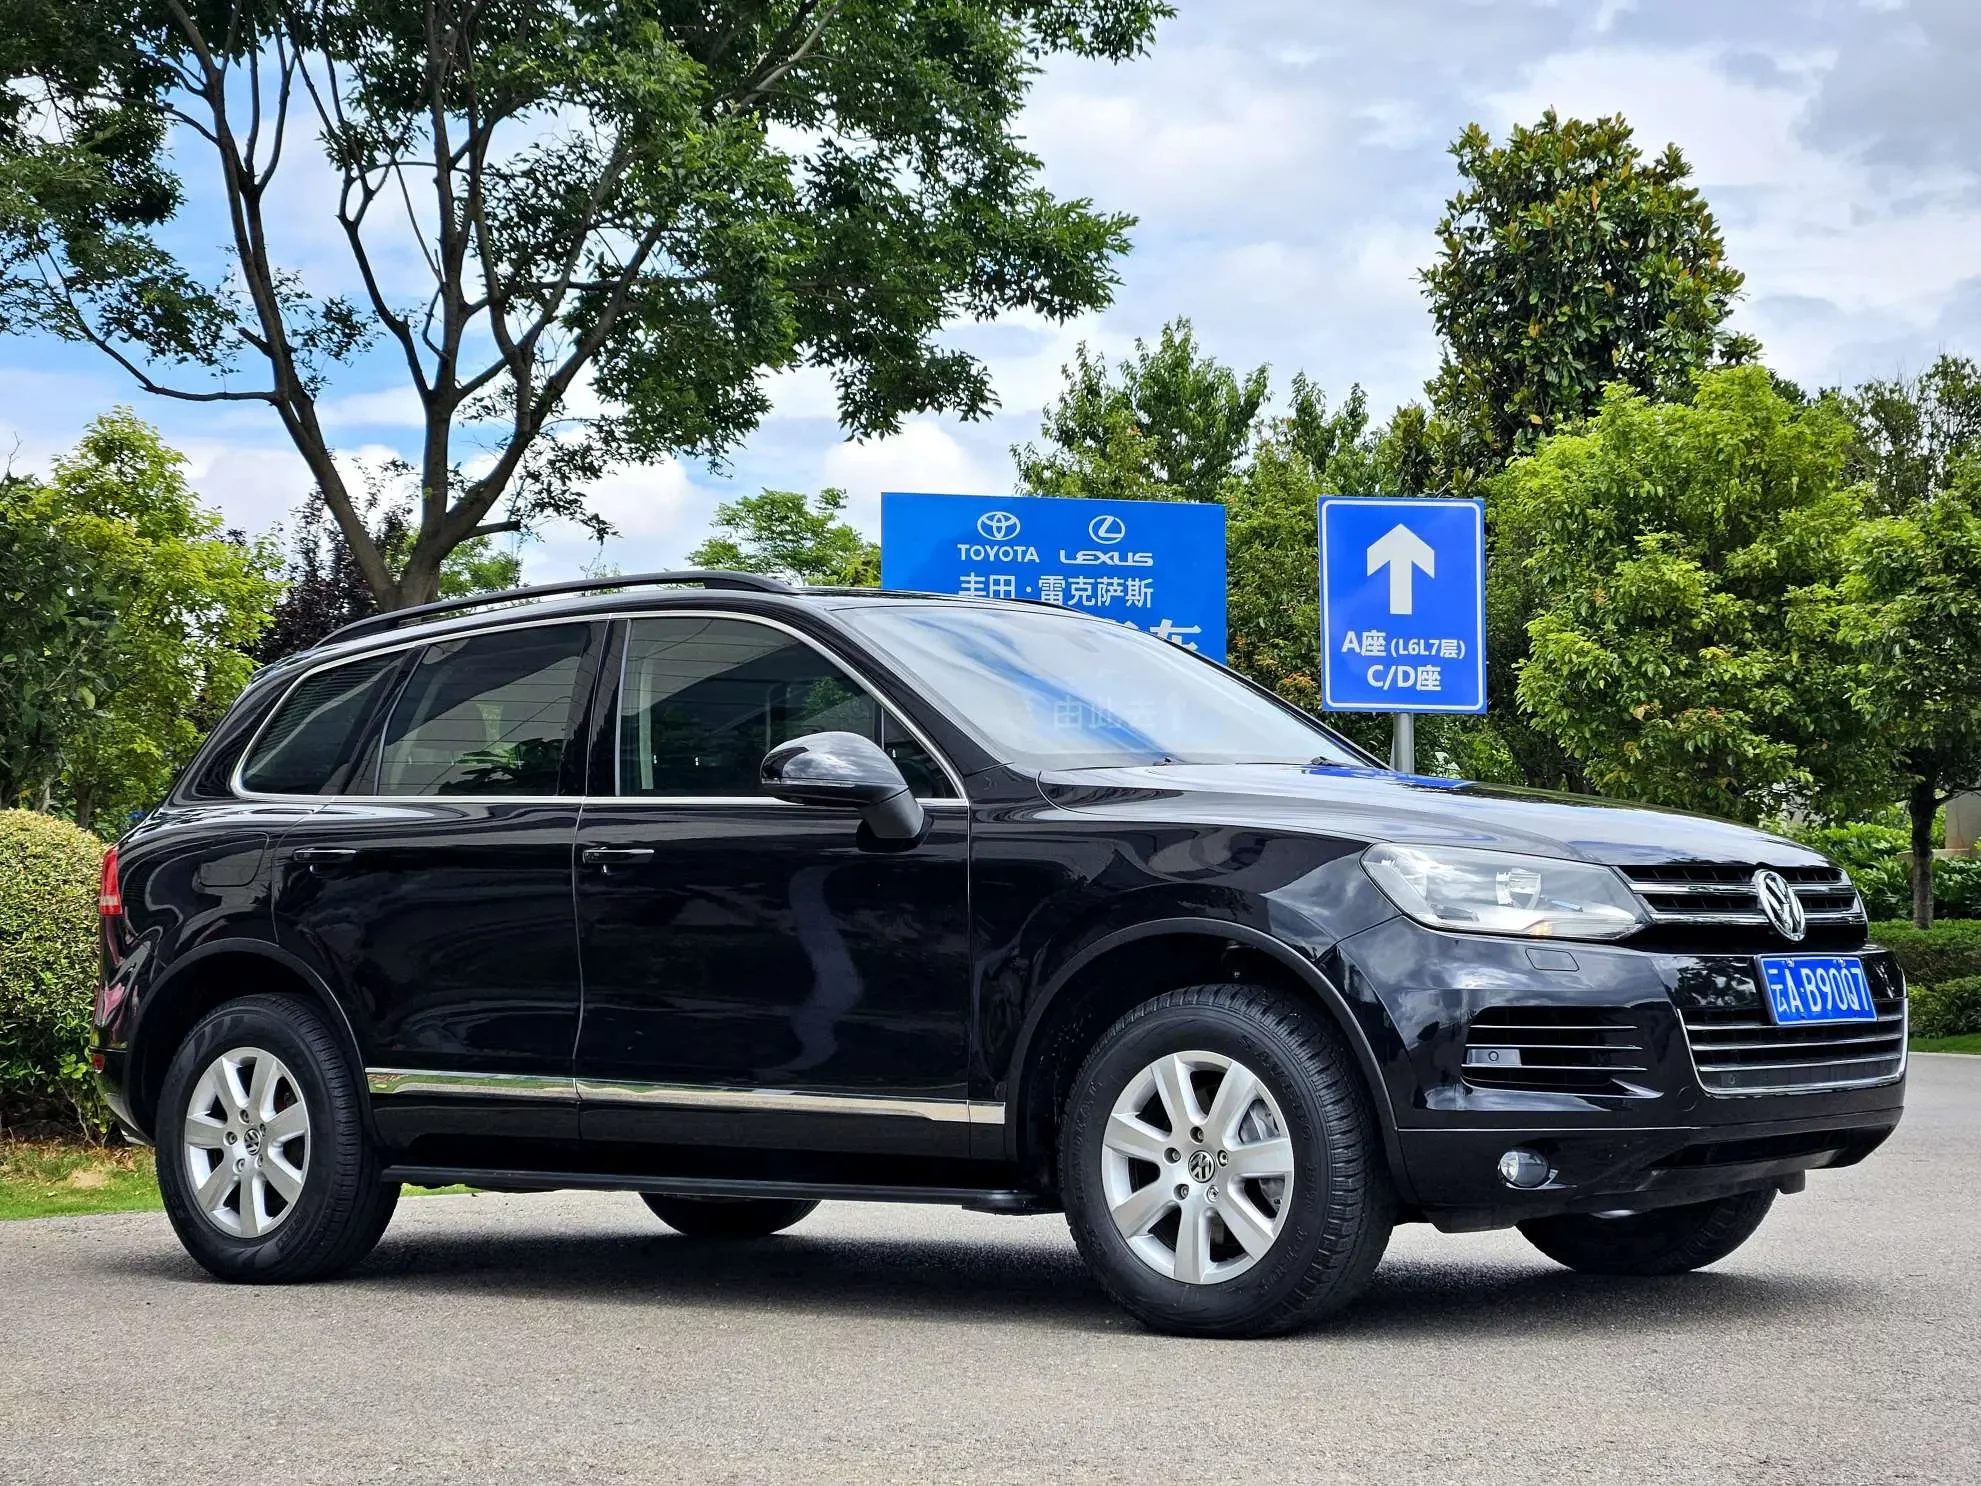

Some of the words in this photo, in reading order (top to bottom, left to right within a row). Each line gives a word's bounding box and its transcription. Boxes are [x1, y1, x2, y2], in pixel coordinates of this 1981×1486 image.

[957, 544, 1040, 563] TOYOTA
[1059, 549, 1154, 567] LEXUS
[1341, 630, 1387, 657] A座
[1367, 664, 1442, 691] C/D座
